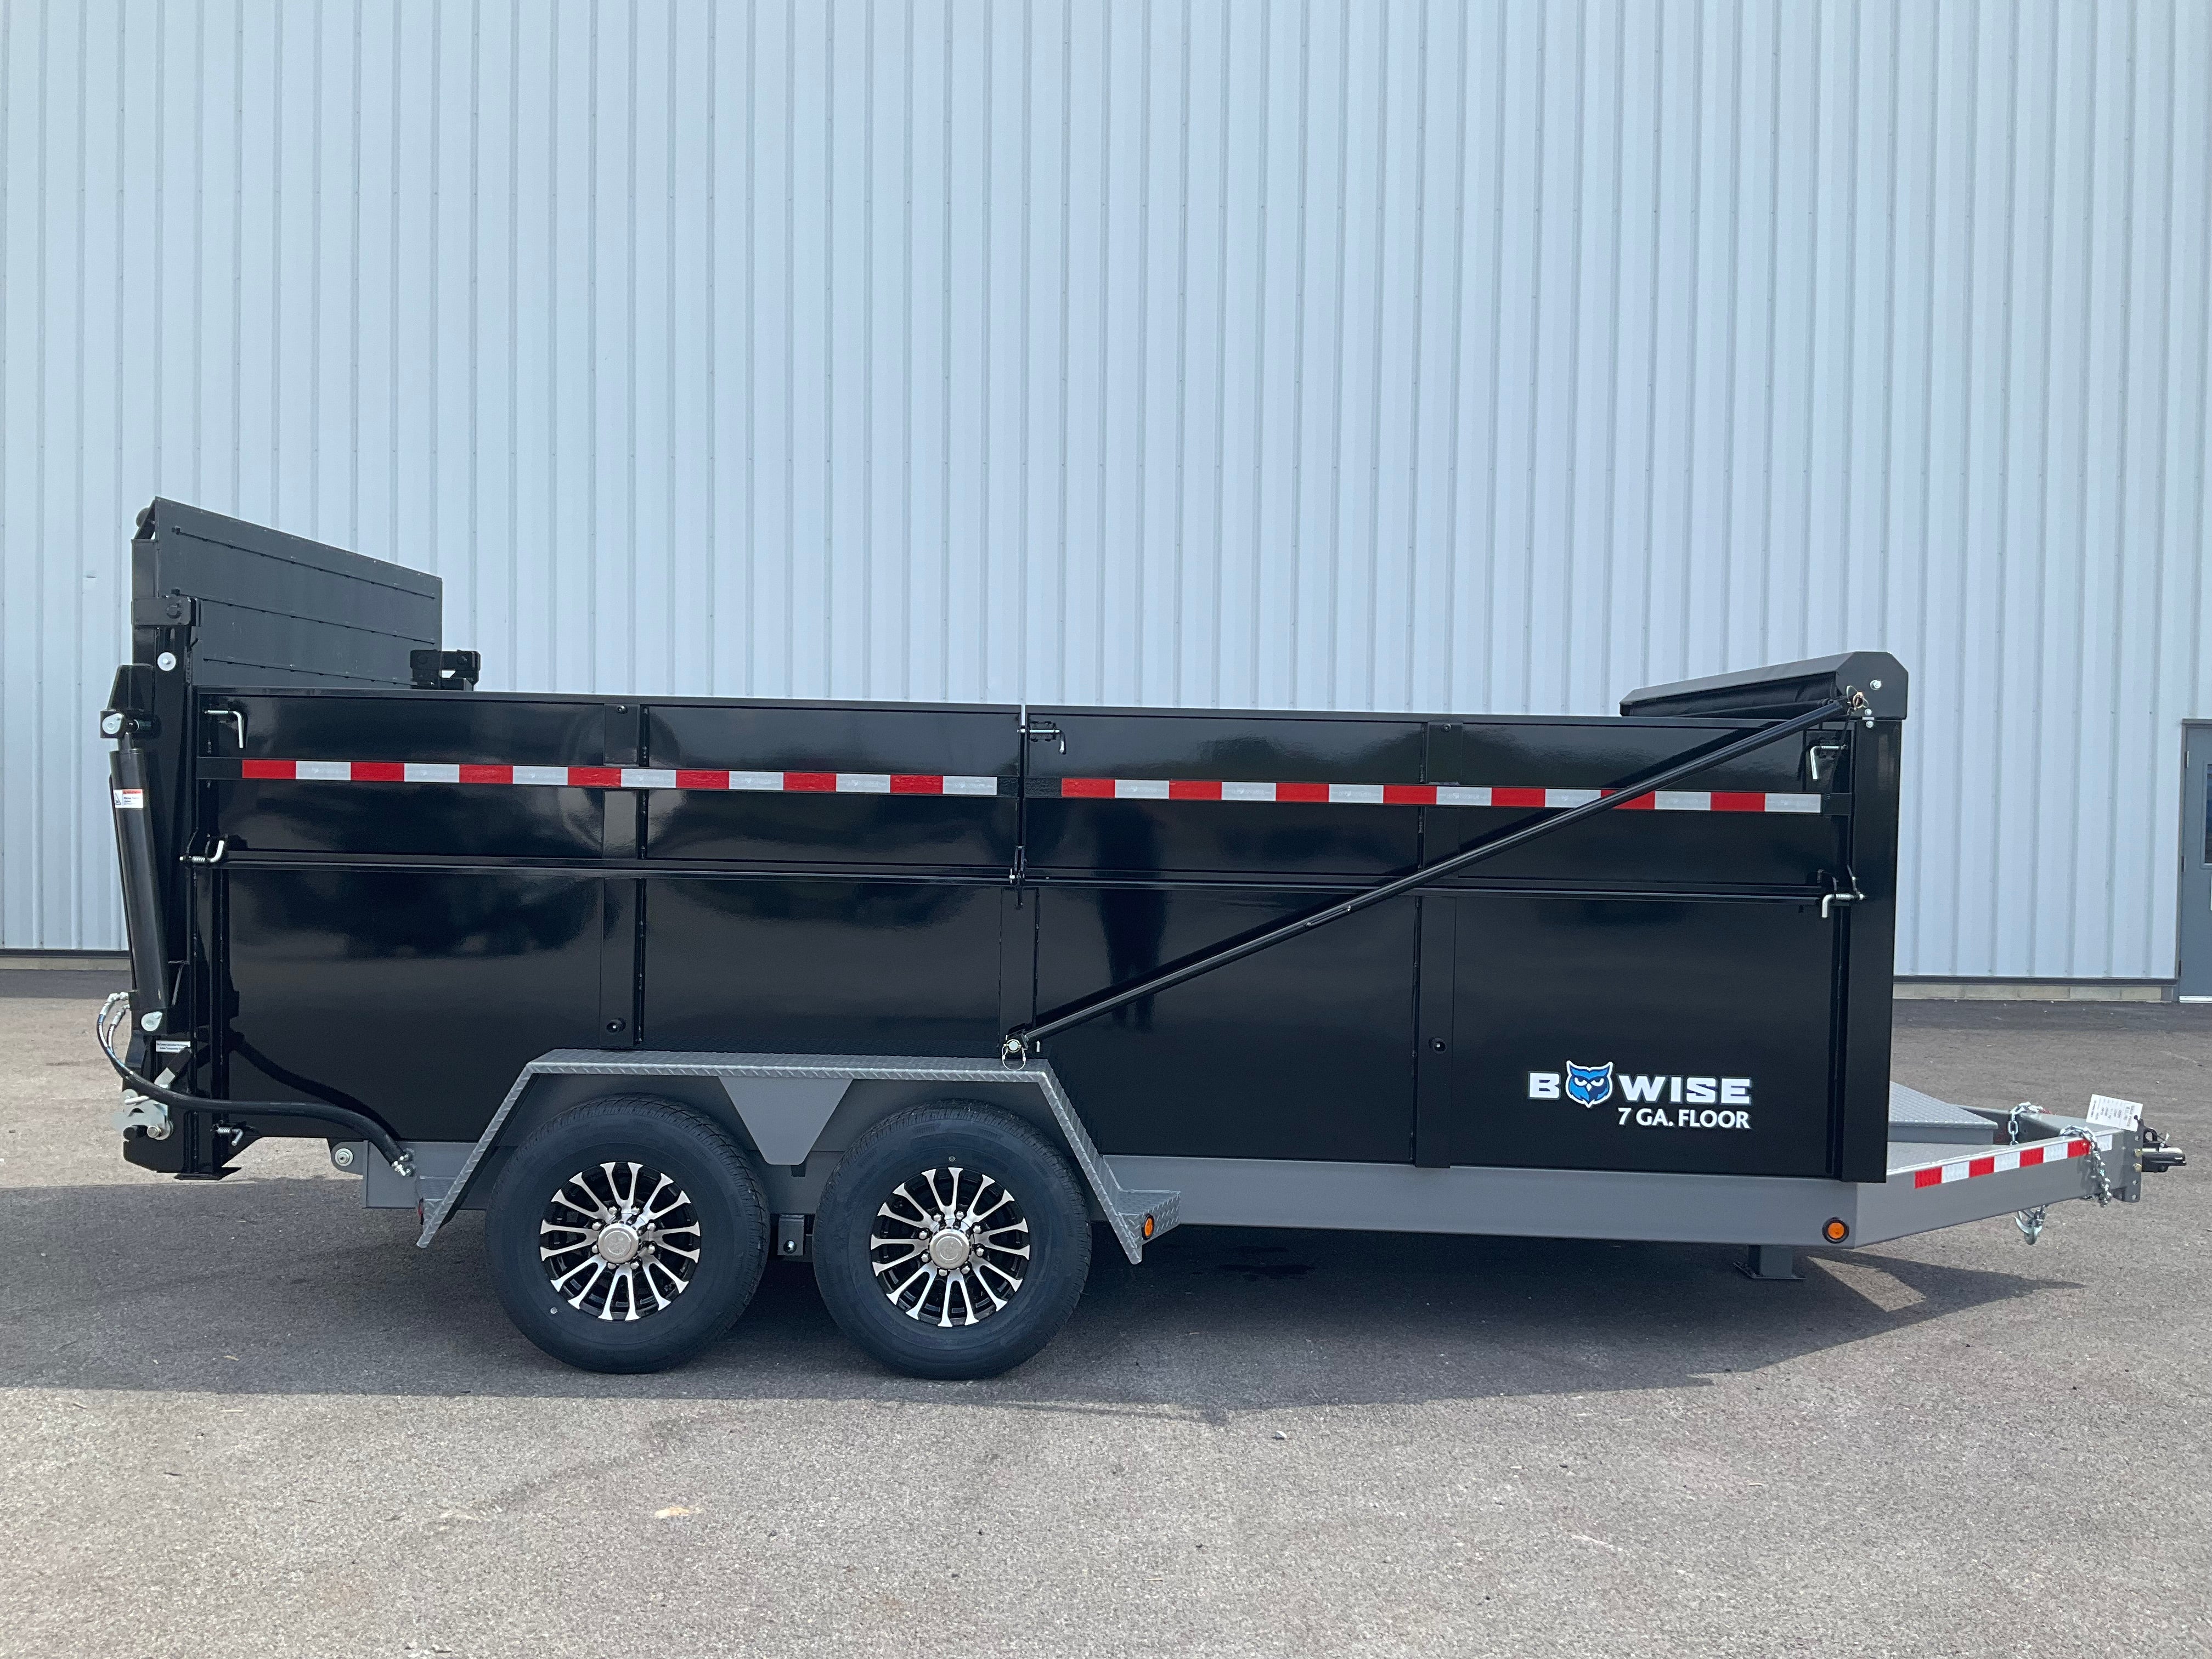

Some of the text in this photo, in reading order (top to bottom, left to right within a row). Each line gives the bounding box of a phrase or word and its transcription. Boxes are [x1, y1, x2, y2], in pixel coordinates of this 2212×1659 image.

[1618, 1107, 1751, 1128] 7 GA. FLOOR
